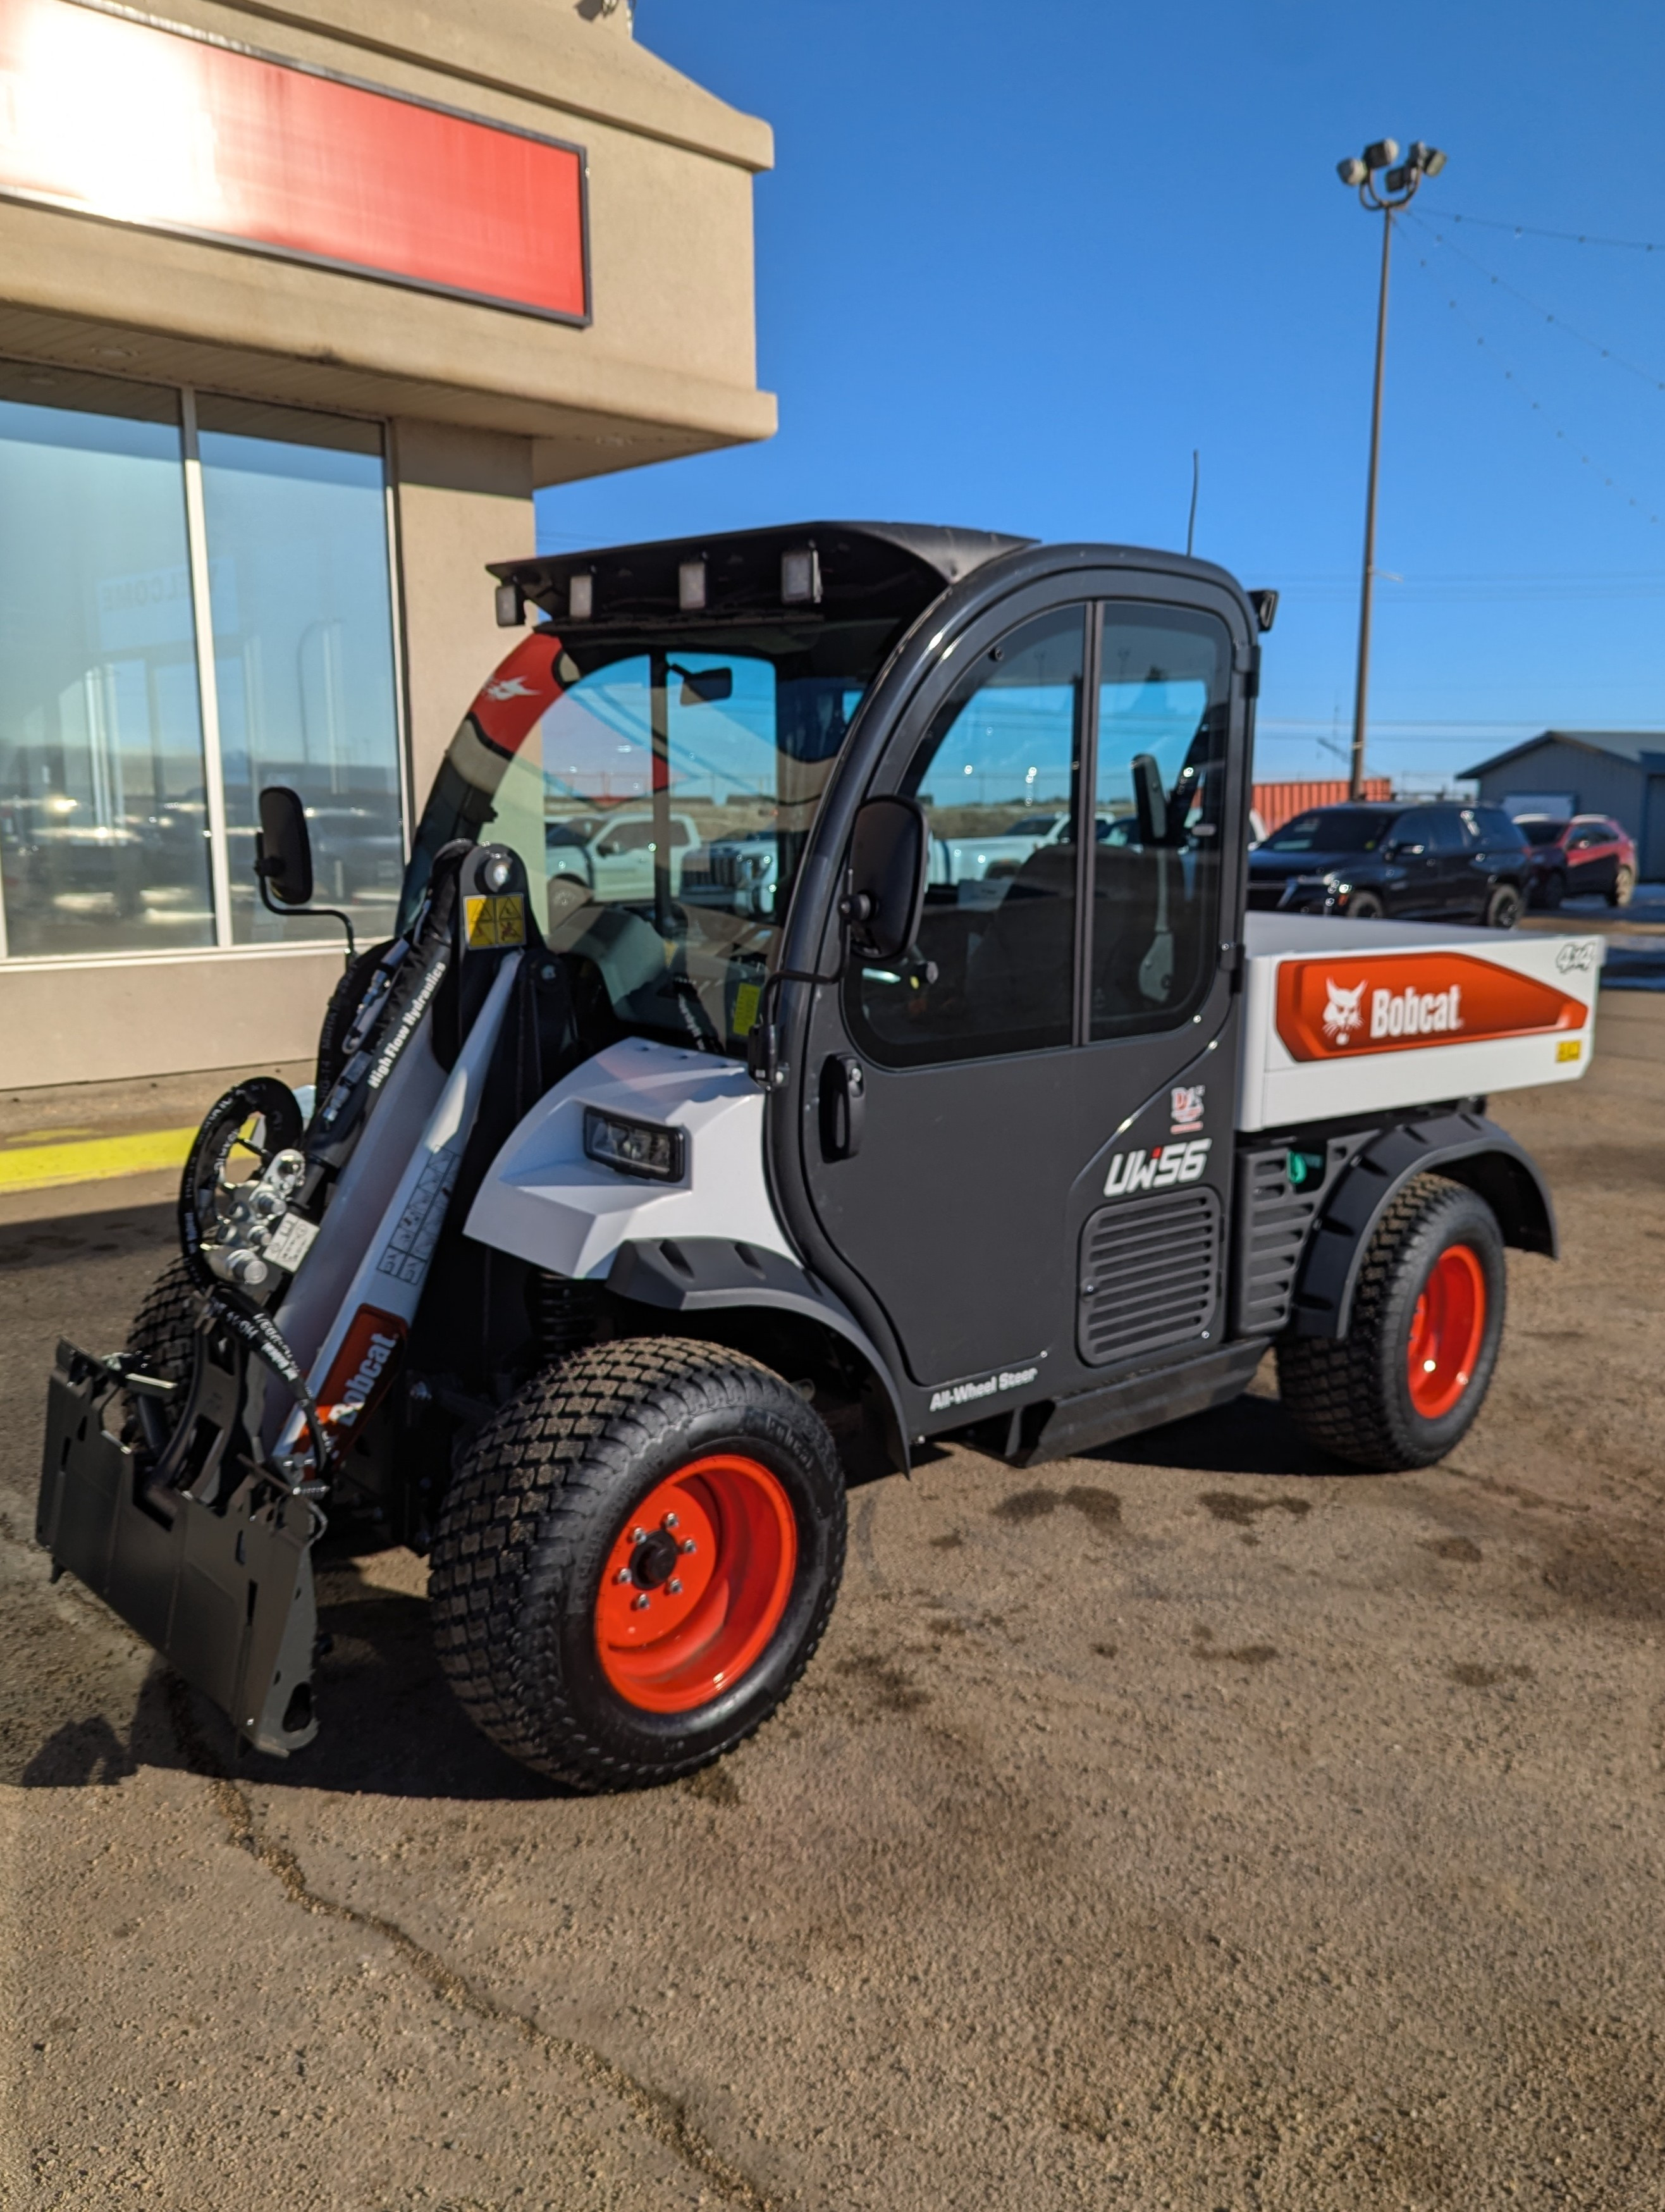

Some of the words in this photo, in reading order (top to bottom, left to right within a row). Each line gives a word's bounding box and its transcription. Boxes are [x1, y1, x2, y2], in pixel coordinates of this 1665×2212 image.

[367, 1057, 393, 1089] High
[384, 1025, 410, 1058] Flow
[402, 961, 446, 1026] Hydraulics
[1370, 984, 1461, 1039] Bobcat
[328, 1333, 397, 1426] Bobcat
[930, 1376, 997, 1411] All-Wheel
[998, 1367, 1038, 1390] Steer
